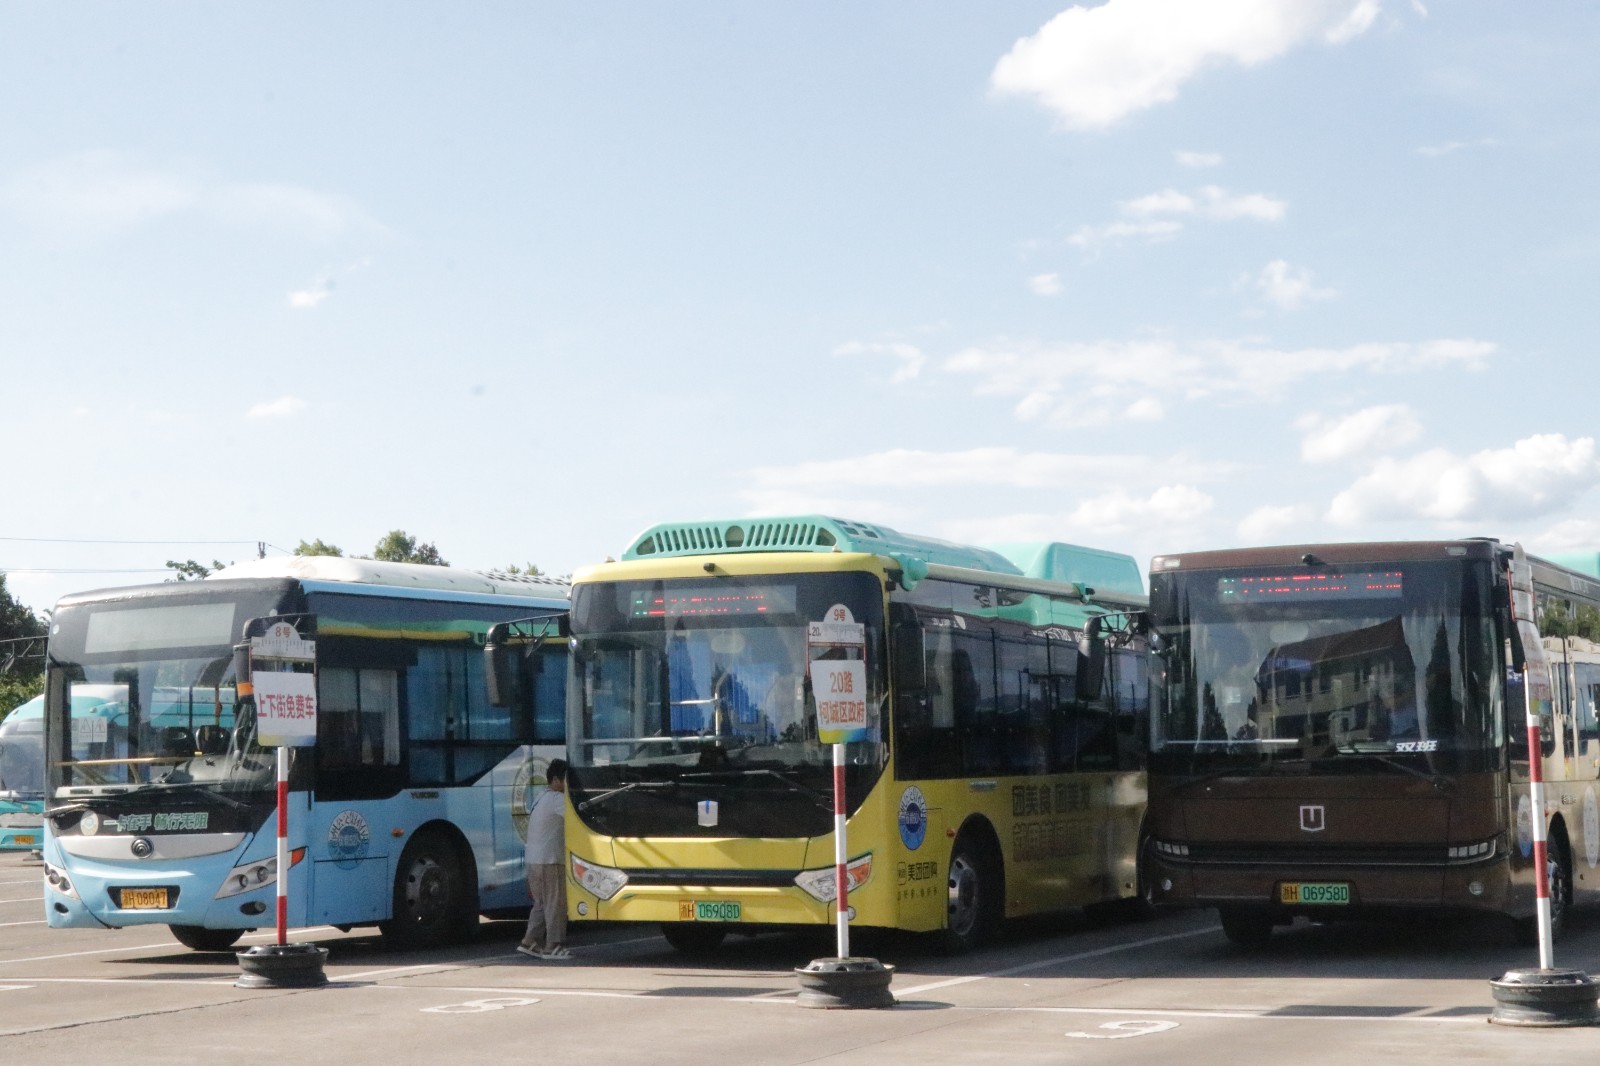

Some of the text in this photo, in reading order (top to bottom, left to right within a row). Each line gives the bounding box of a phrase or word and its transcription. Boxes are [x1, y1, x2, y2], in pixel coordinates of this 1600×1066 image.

[833, 608, 846, 621] 9号
[275, 626, 291, 638] 8号
[829, 670, 853, 694] 20路
[257, 693, 315, 719] 上下街免费车
[819, 699, 865, 724] 柯城区政府
[103, 812, 208, 831] 一卡在手 畅行无阻
